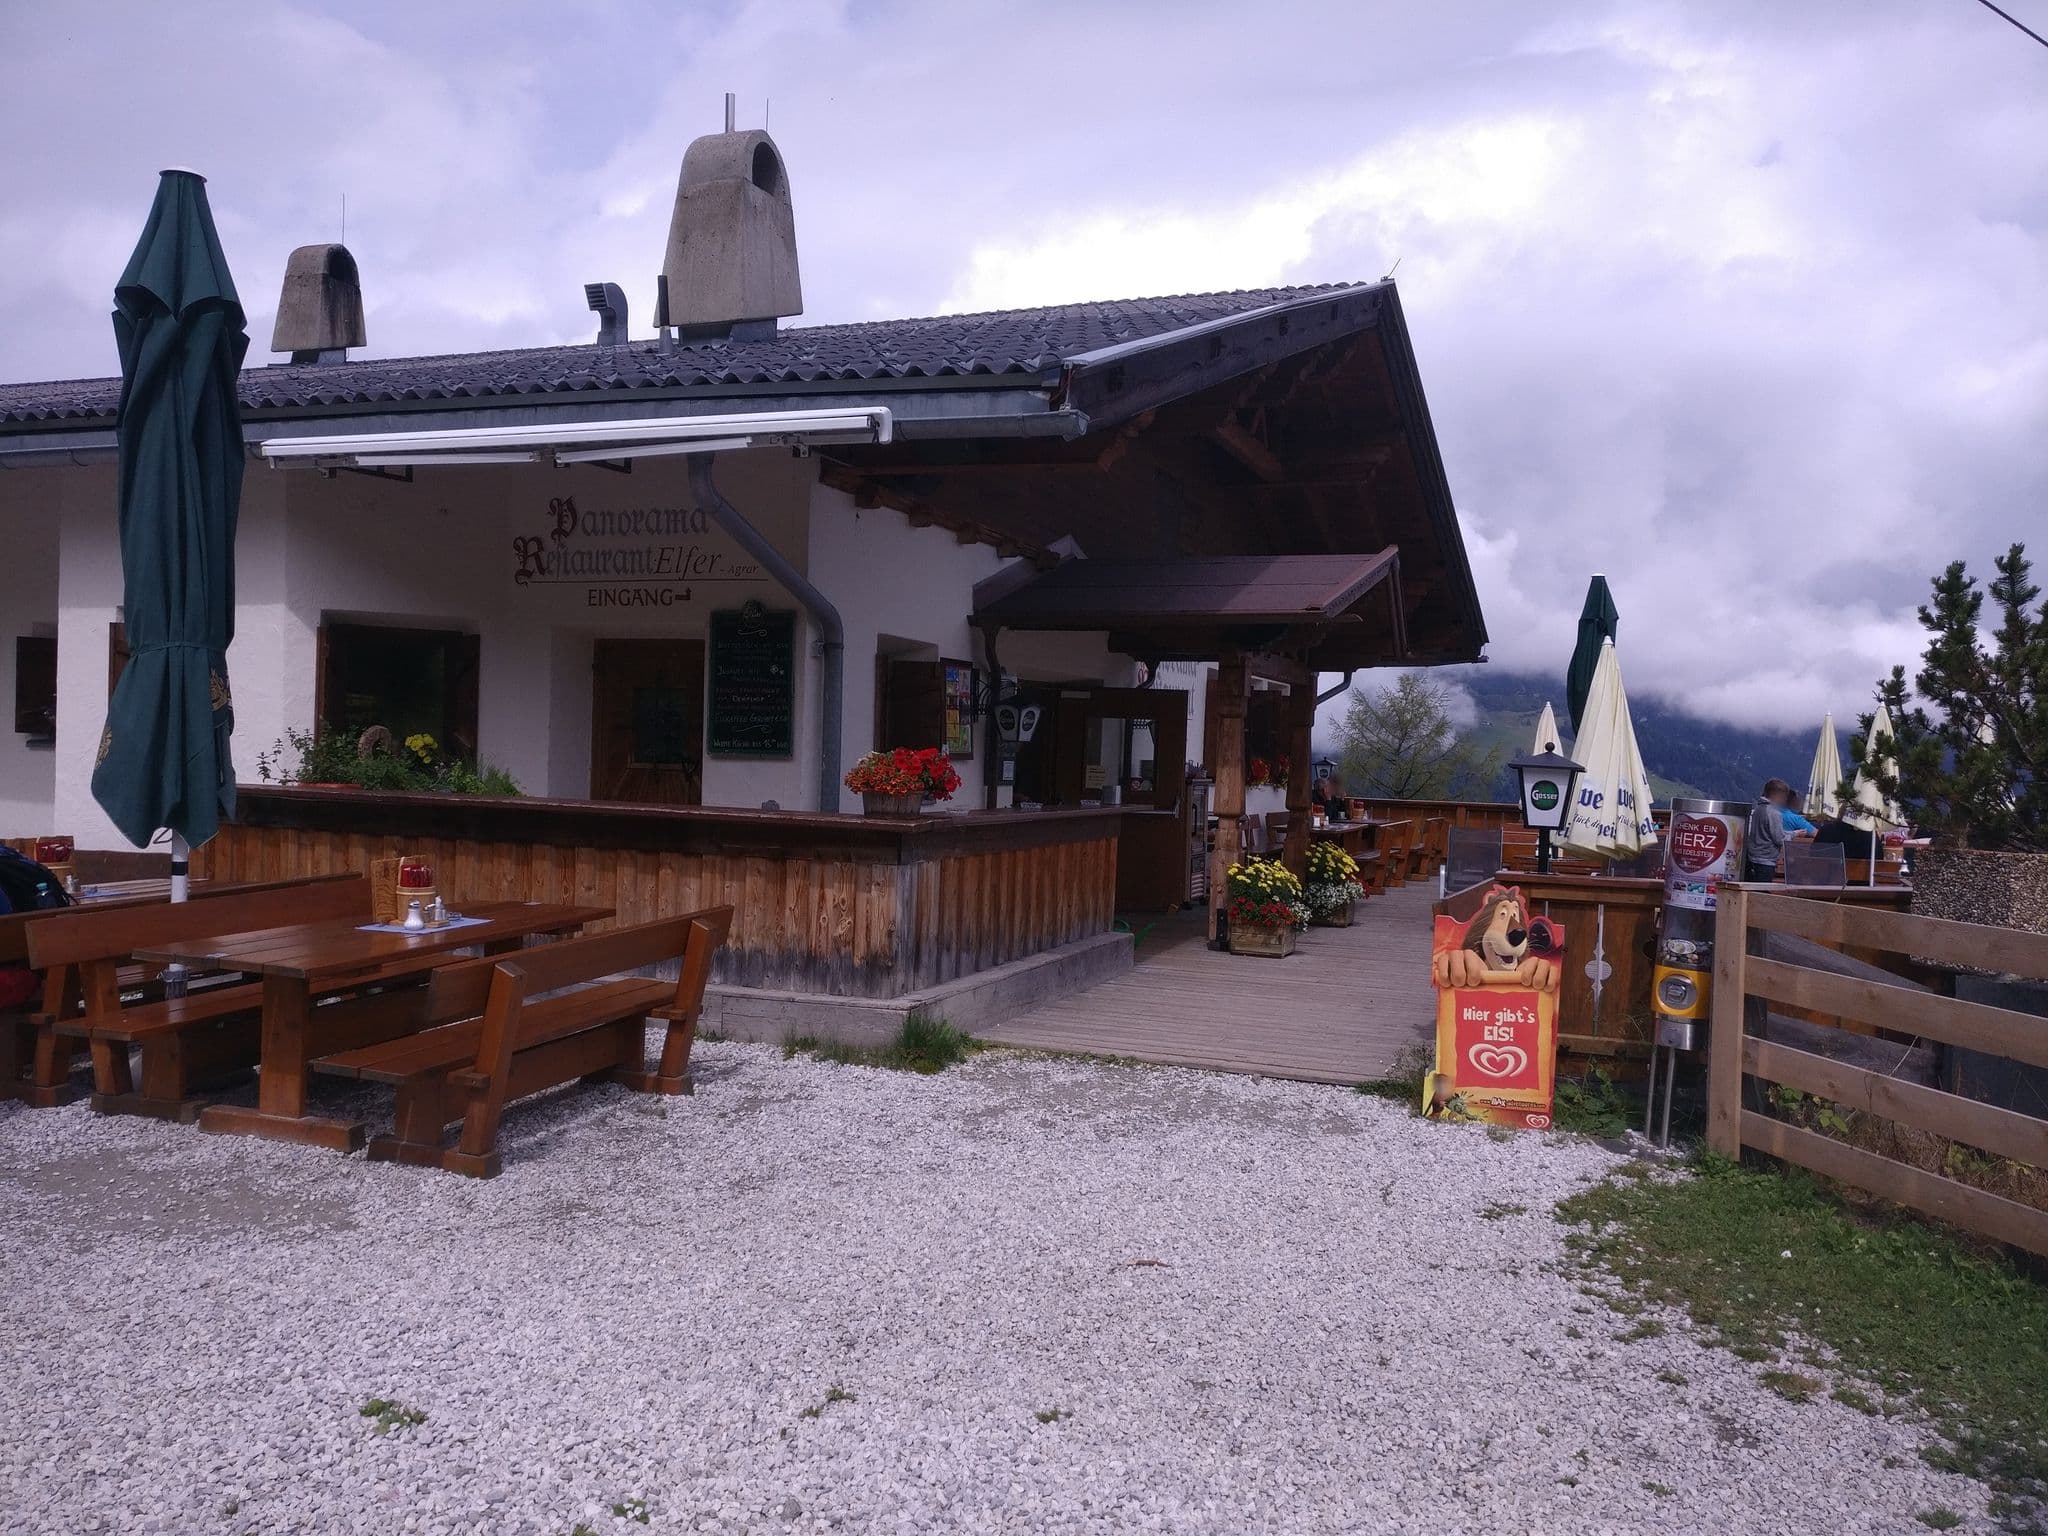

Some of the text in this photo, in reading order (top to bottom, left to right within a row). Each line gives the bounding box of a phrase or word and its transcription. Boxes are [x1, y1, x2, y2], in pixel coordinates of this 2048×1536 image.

[547, 496, 709, 543] Panorama
[588, 588, 674, 607] EINGANG
[1703, 824, 1718, 833] EIN
[1675, 831, 1717, 850] HERZ
[1463, 1005, 1490, 1021] Hier
[1484, 1025, 1514, 1042] EIS!
